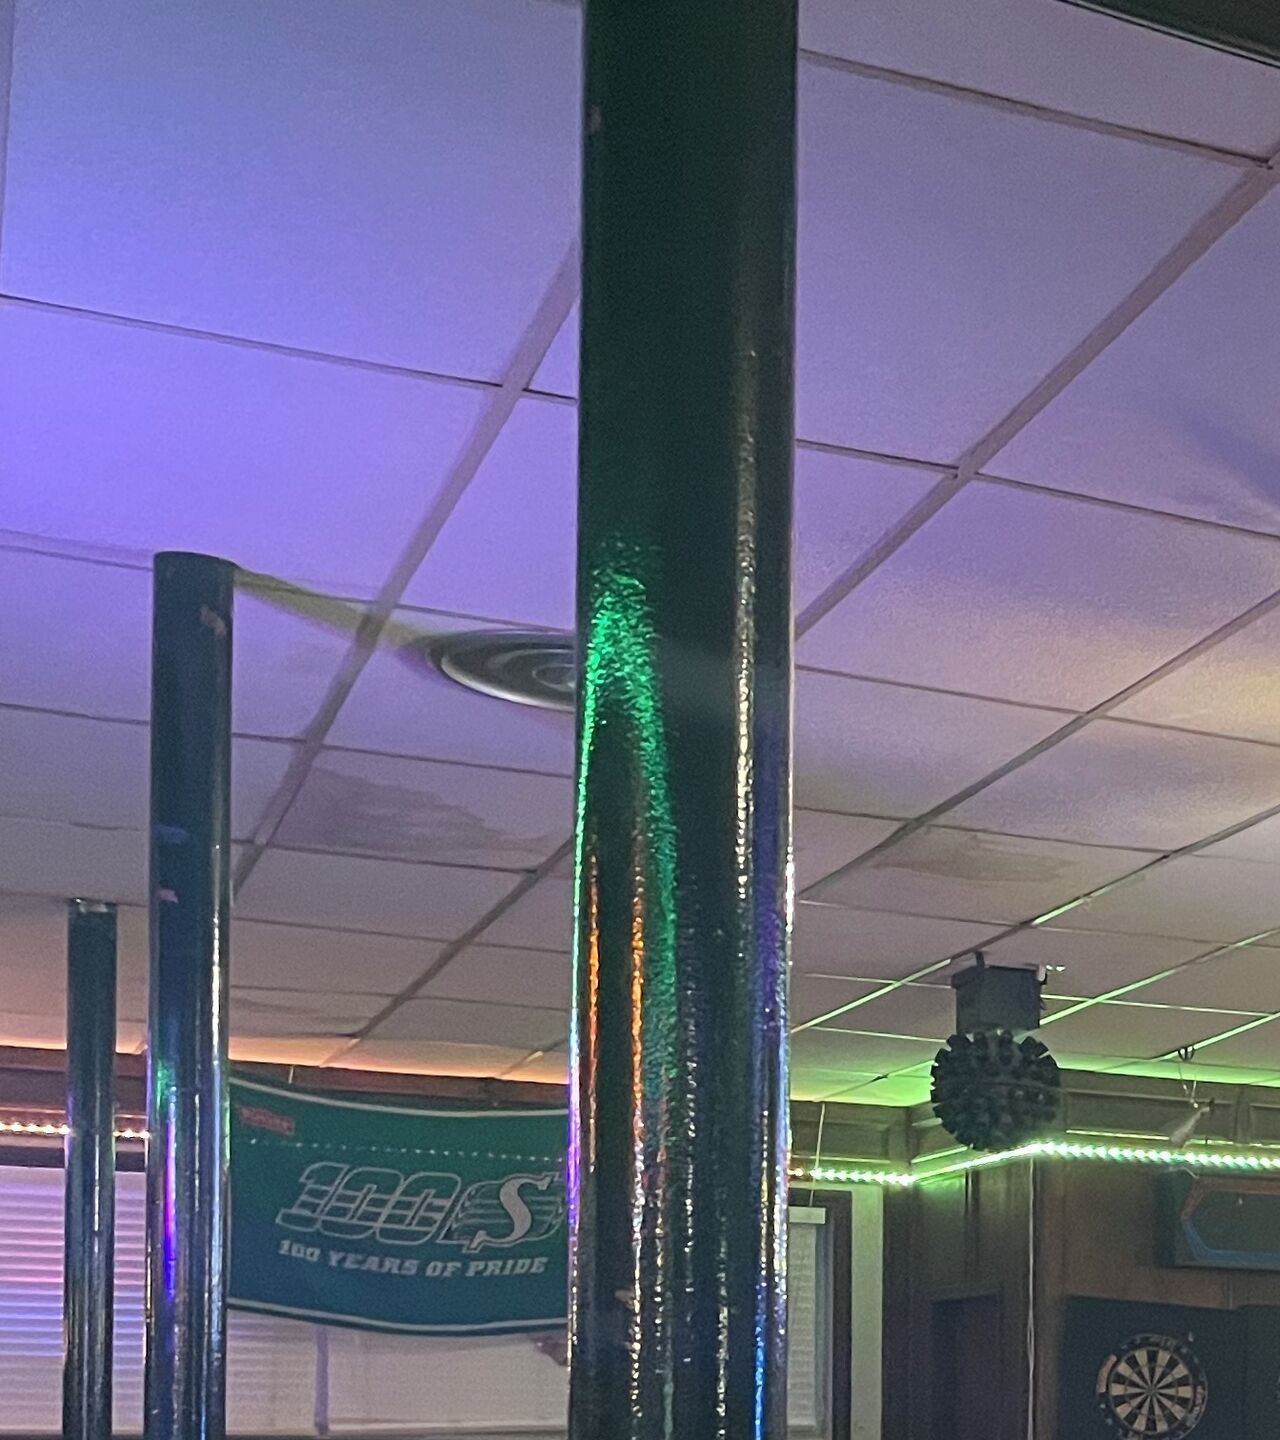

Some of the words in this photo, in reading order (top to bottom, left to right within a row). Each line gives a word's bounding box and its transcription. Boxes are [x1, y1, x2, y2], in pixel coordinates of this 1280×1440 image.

[278, 1240, 321, 1263] 100
[329, 1248, 418, 1276] YEARS
[425, 1256, 461, 1277] OF
[466, 1256, 549, 1278] PRIDE
